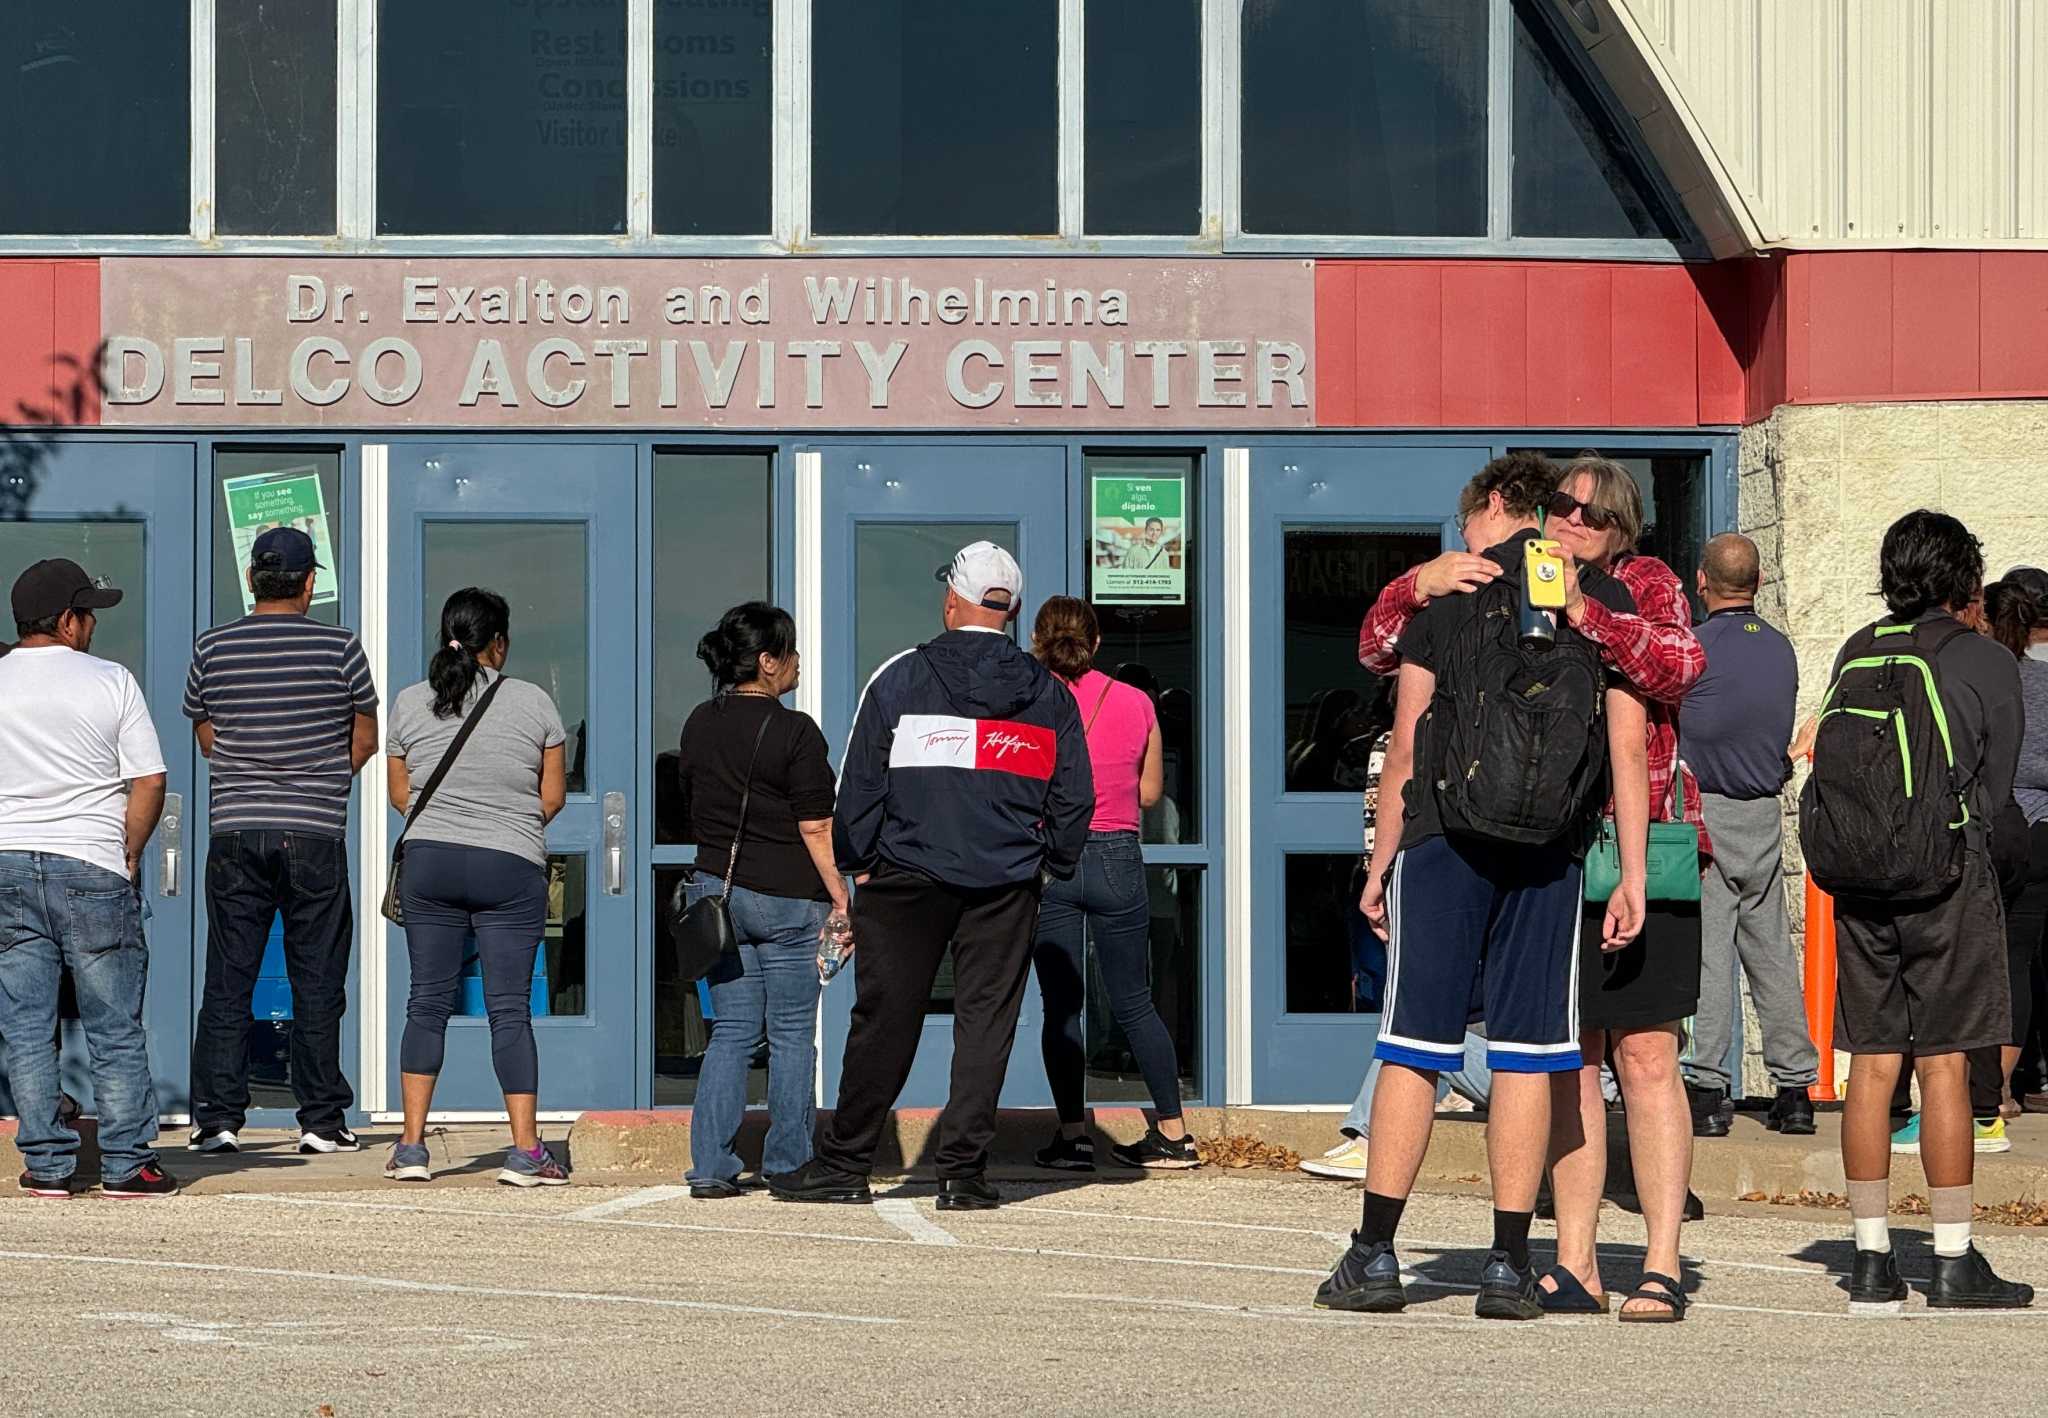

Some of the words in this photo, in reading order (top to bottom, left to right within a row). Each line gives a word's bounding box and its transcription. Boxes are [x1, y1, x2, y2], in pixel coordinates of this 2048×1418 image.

[287, 275, 370, 324] Dr.
[403, 275, 631, 324] Exalton
[664, 277, 771, 326] and
[803, 276, 1129, 327] Wilhelmina
[105, 335, 424, 407] DELCO
[458, 338, 910, 410] ACTIVITY
[944, 338, 1309, 410] CENTER
[261, 489, 275, 500] you
[276, 487, 293, 496] see
[247, 511, 263, 521] say
[918, 729, 971, 756] Tommy
